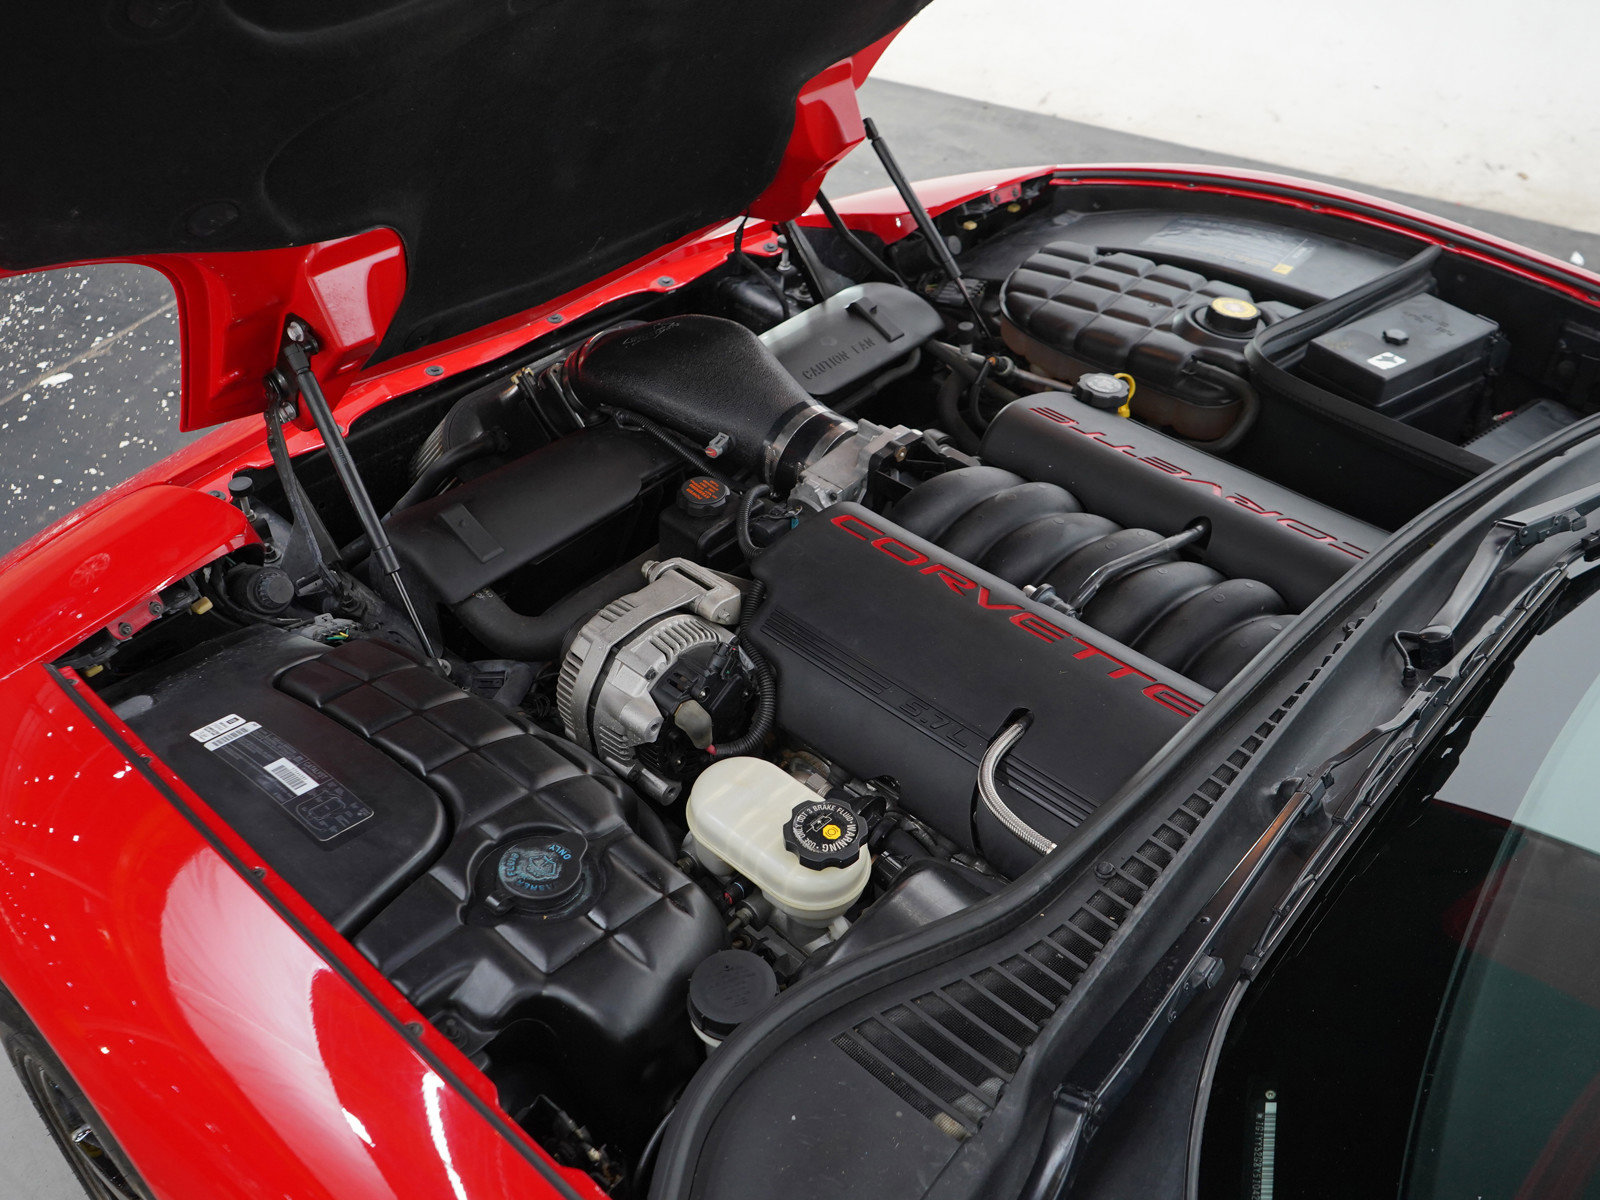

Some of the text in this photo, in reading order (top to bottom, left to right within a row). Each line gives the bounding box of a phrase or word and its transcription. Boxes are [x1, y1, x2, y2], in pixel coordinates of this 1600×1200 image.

[802, 351, 850, 380] CAUTION
[1029, 406, 1370, 560] CORVETTE
[830, 514, 1206, 718] CORVETTE
[899, 701, 969, 749] 5.7L
[797, 811, 808, 823] DOT
[812, 804, 836, 812] BRAKE
[836, 807, 854, 822] FLUID
[822, 824, 857, 852] WARNING
[505, 852, 520, 877] FLUID
[548, 844, 572, 860] ONLY
